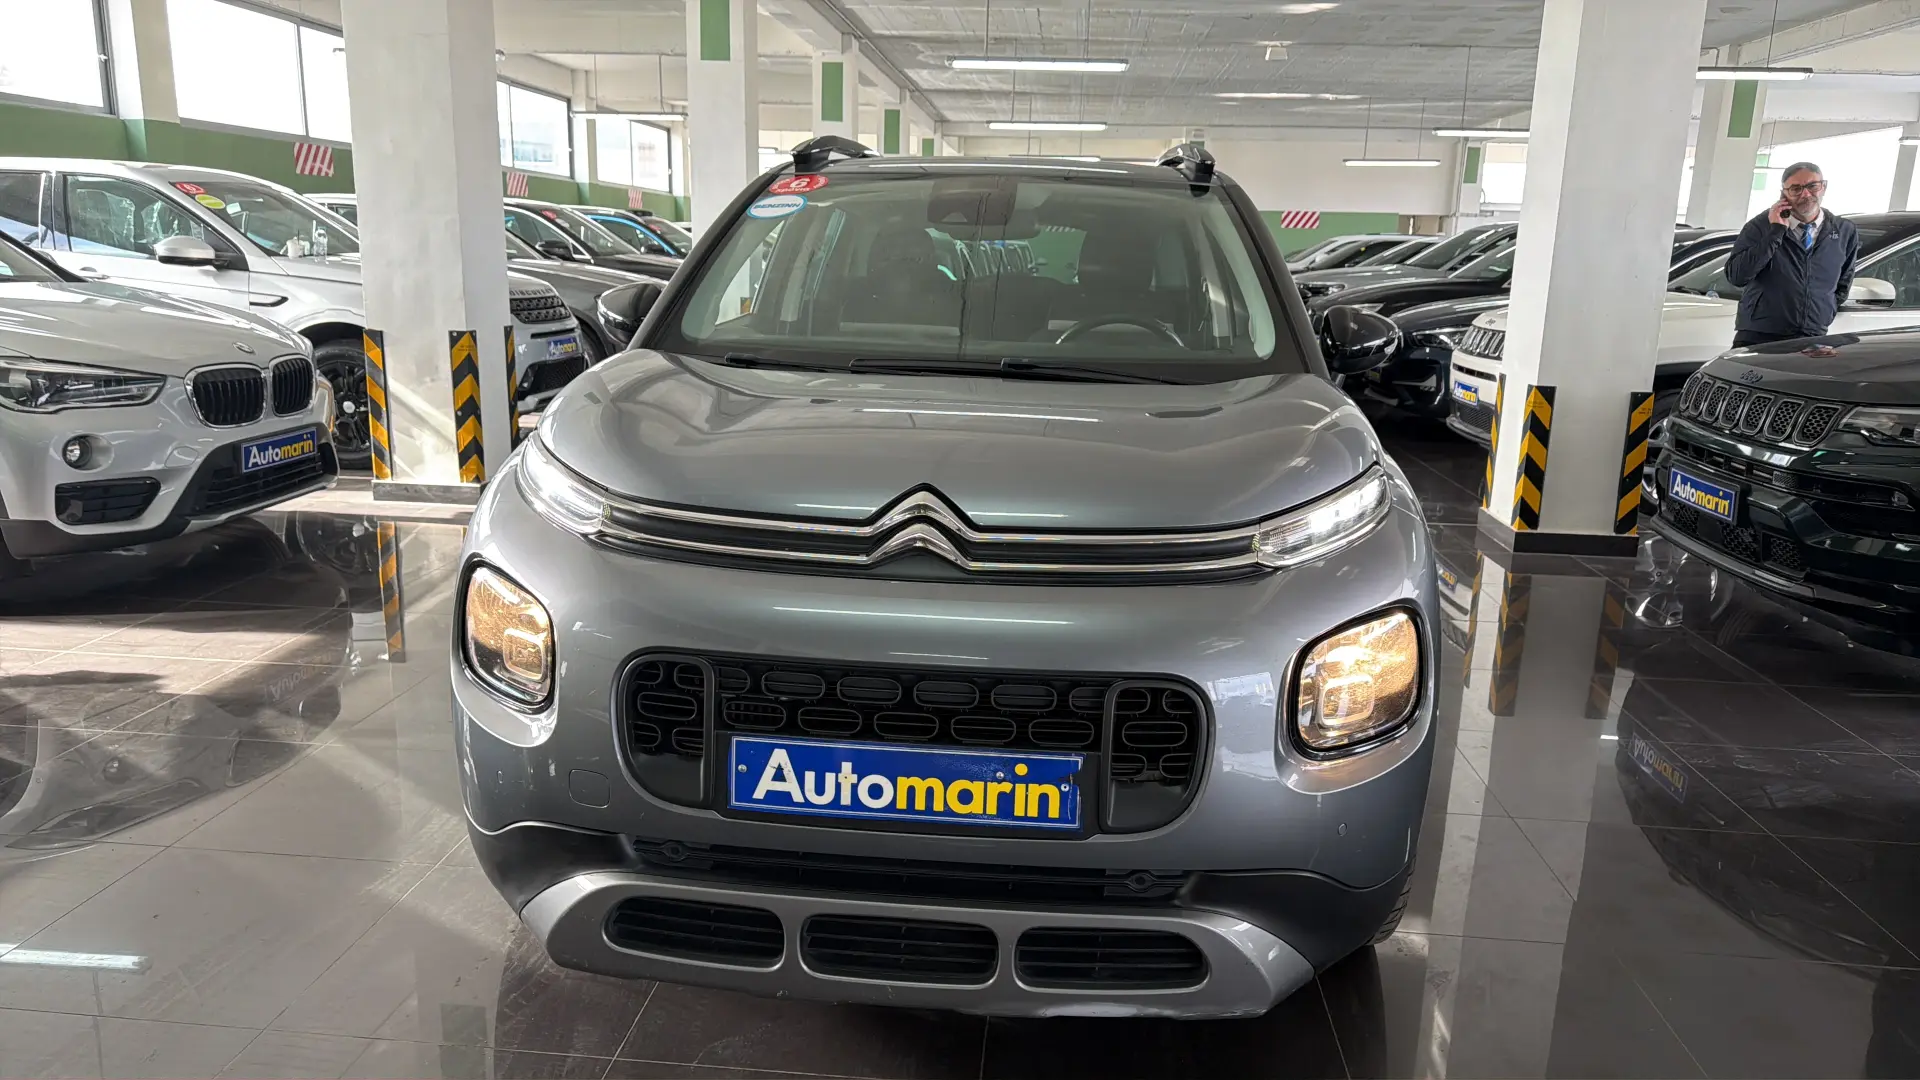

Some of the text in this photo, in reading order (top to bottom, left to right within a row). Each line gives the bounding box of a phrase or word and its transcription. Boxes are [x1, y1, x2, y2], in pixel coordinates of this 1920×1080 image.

[789, 178, 810, 188] 6
[248, 434, 313, 467] Automarin
[1672, 473, 1730, 516] Automarin
[752, 748, 1060, 819] Automarin
